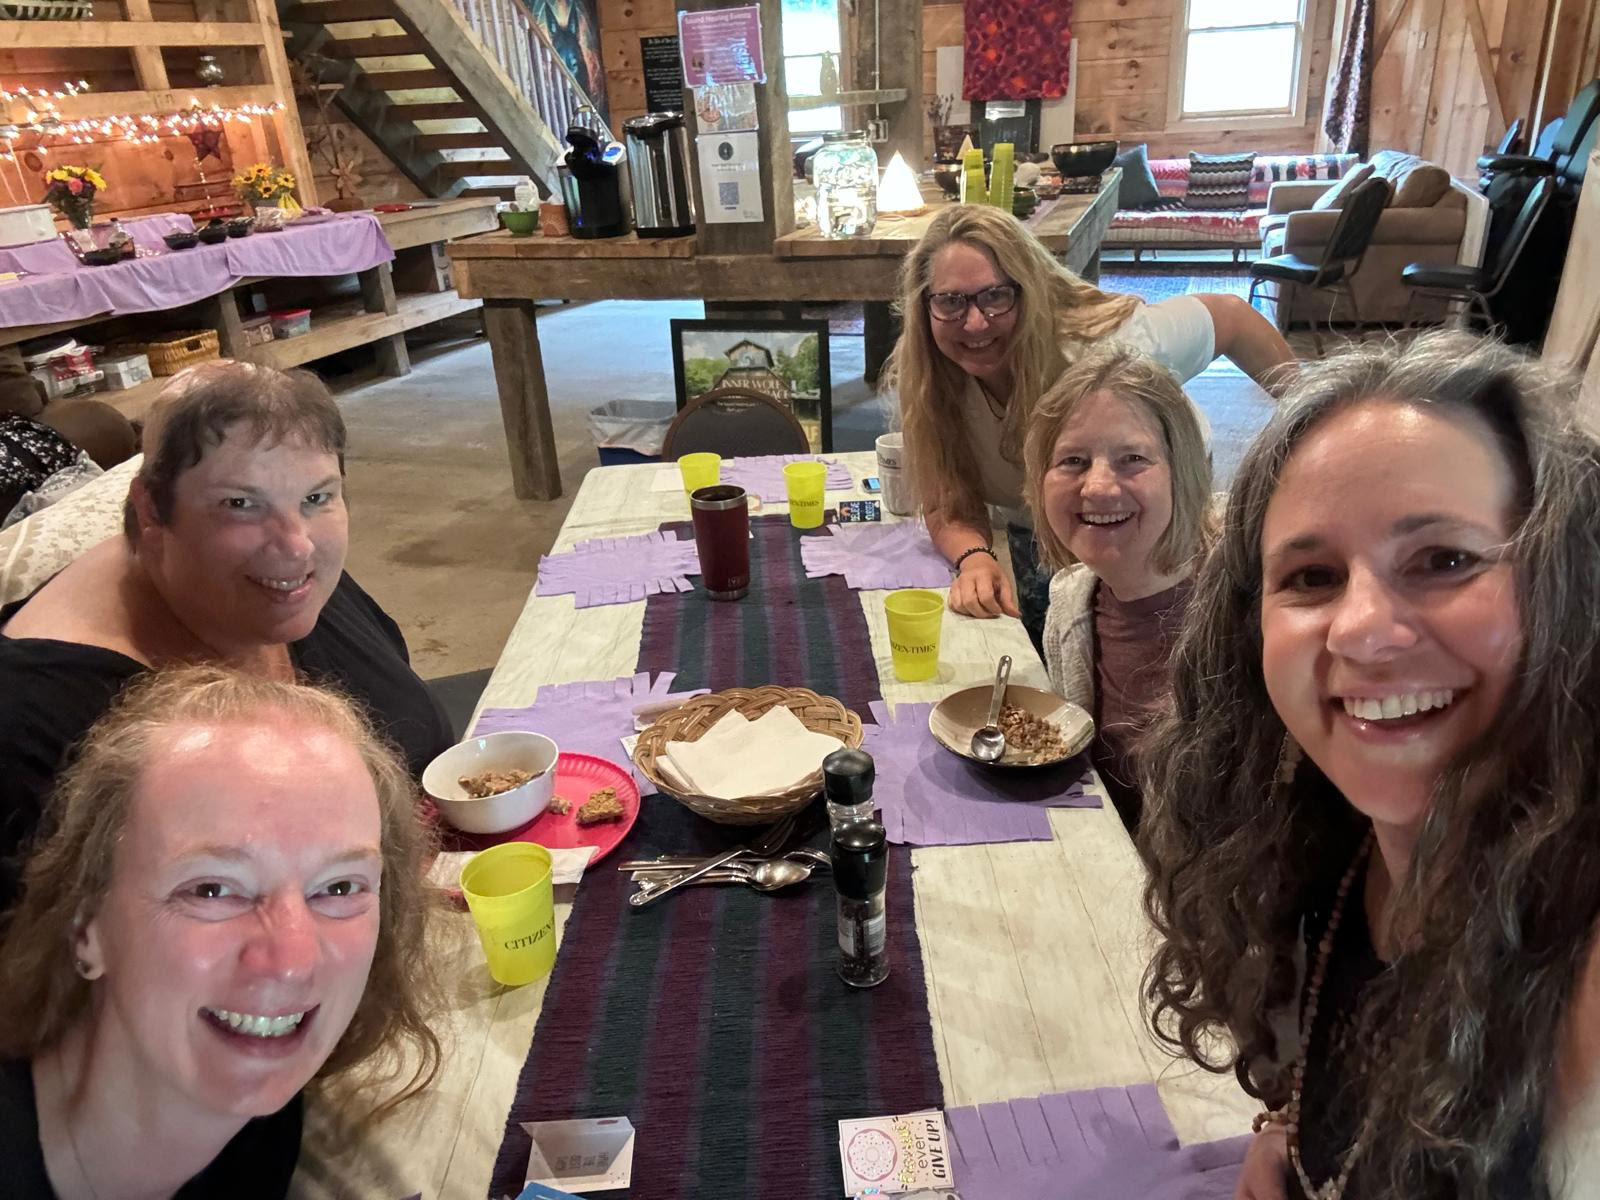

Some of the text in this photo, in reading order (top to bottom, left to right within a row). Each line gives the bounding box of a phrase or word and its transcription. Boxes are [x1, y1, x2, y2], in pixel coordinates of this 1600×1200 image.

[915, 1134, 928, 1168] ever
[926, 1119, 946, 1179] GIVE UP!
